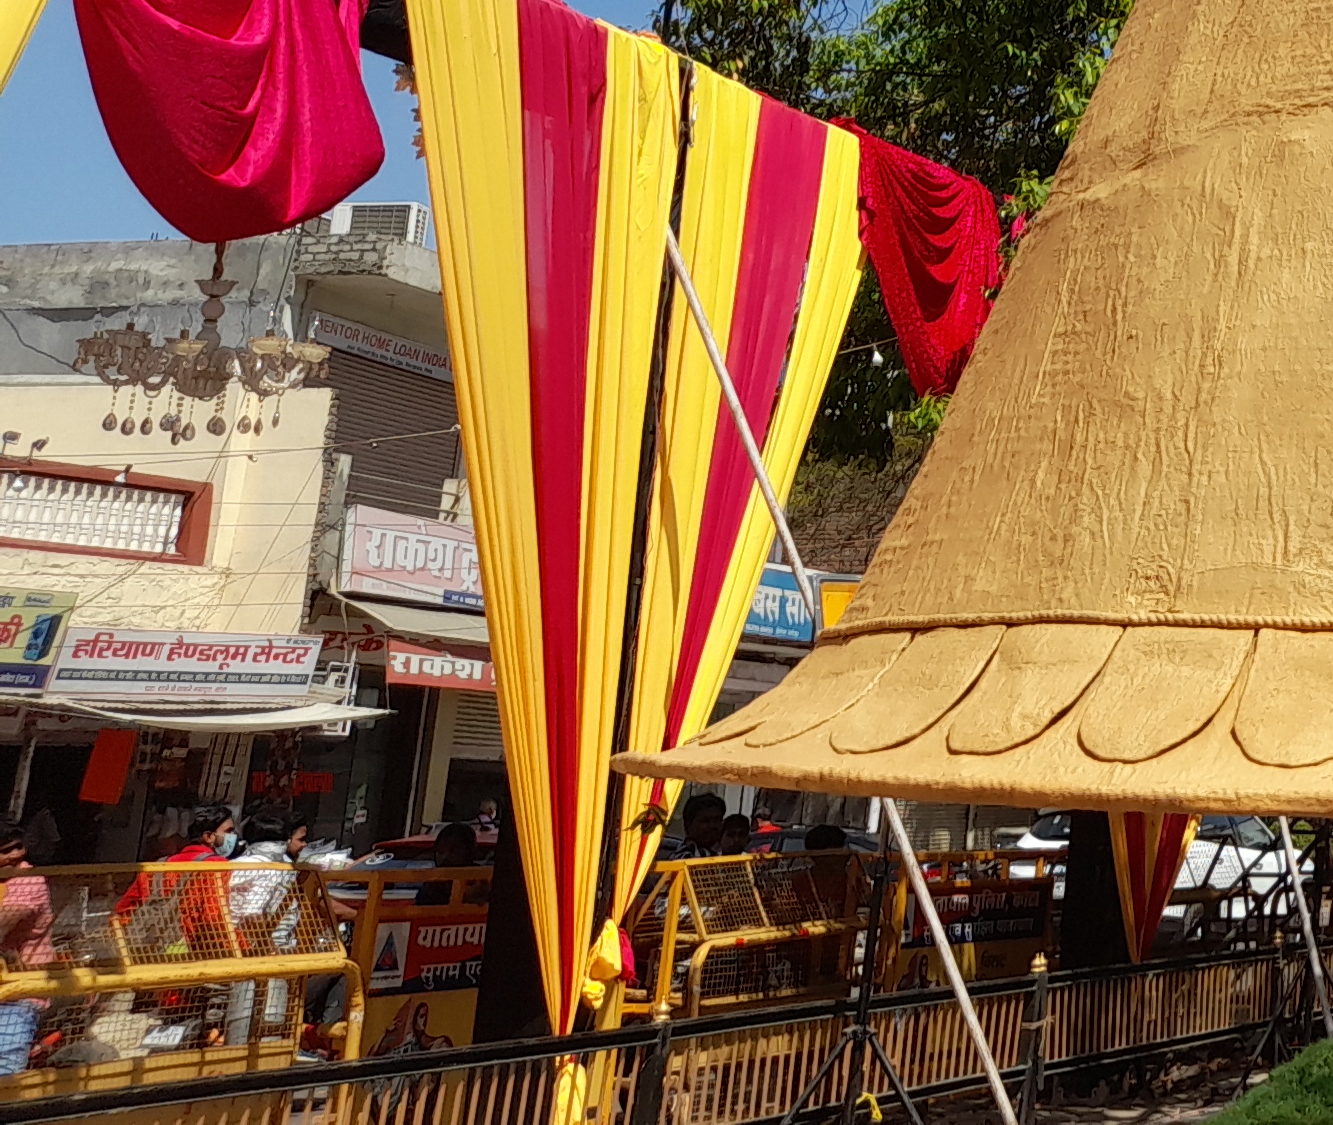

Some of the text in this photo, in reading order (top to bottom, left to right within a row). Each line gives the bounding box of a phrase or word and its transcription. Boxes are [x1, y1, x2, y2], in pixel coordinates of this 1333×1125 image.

[361, 331, 394, 352] HOME
[393, 341, 421, 362] LOAN
[421, 349, 448, 369] INDIA
[365, 519, 459, 580] राकेश
[252, 638, 312, 665] सेन्टर
[389, 651, 485, 680] राकेश
[971, 889, 1009, 917] पुलिस,
[417, 922, 487, 948] याताया
[420, 962, 462, 990] सुगम
